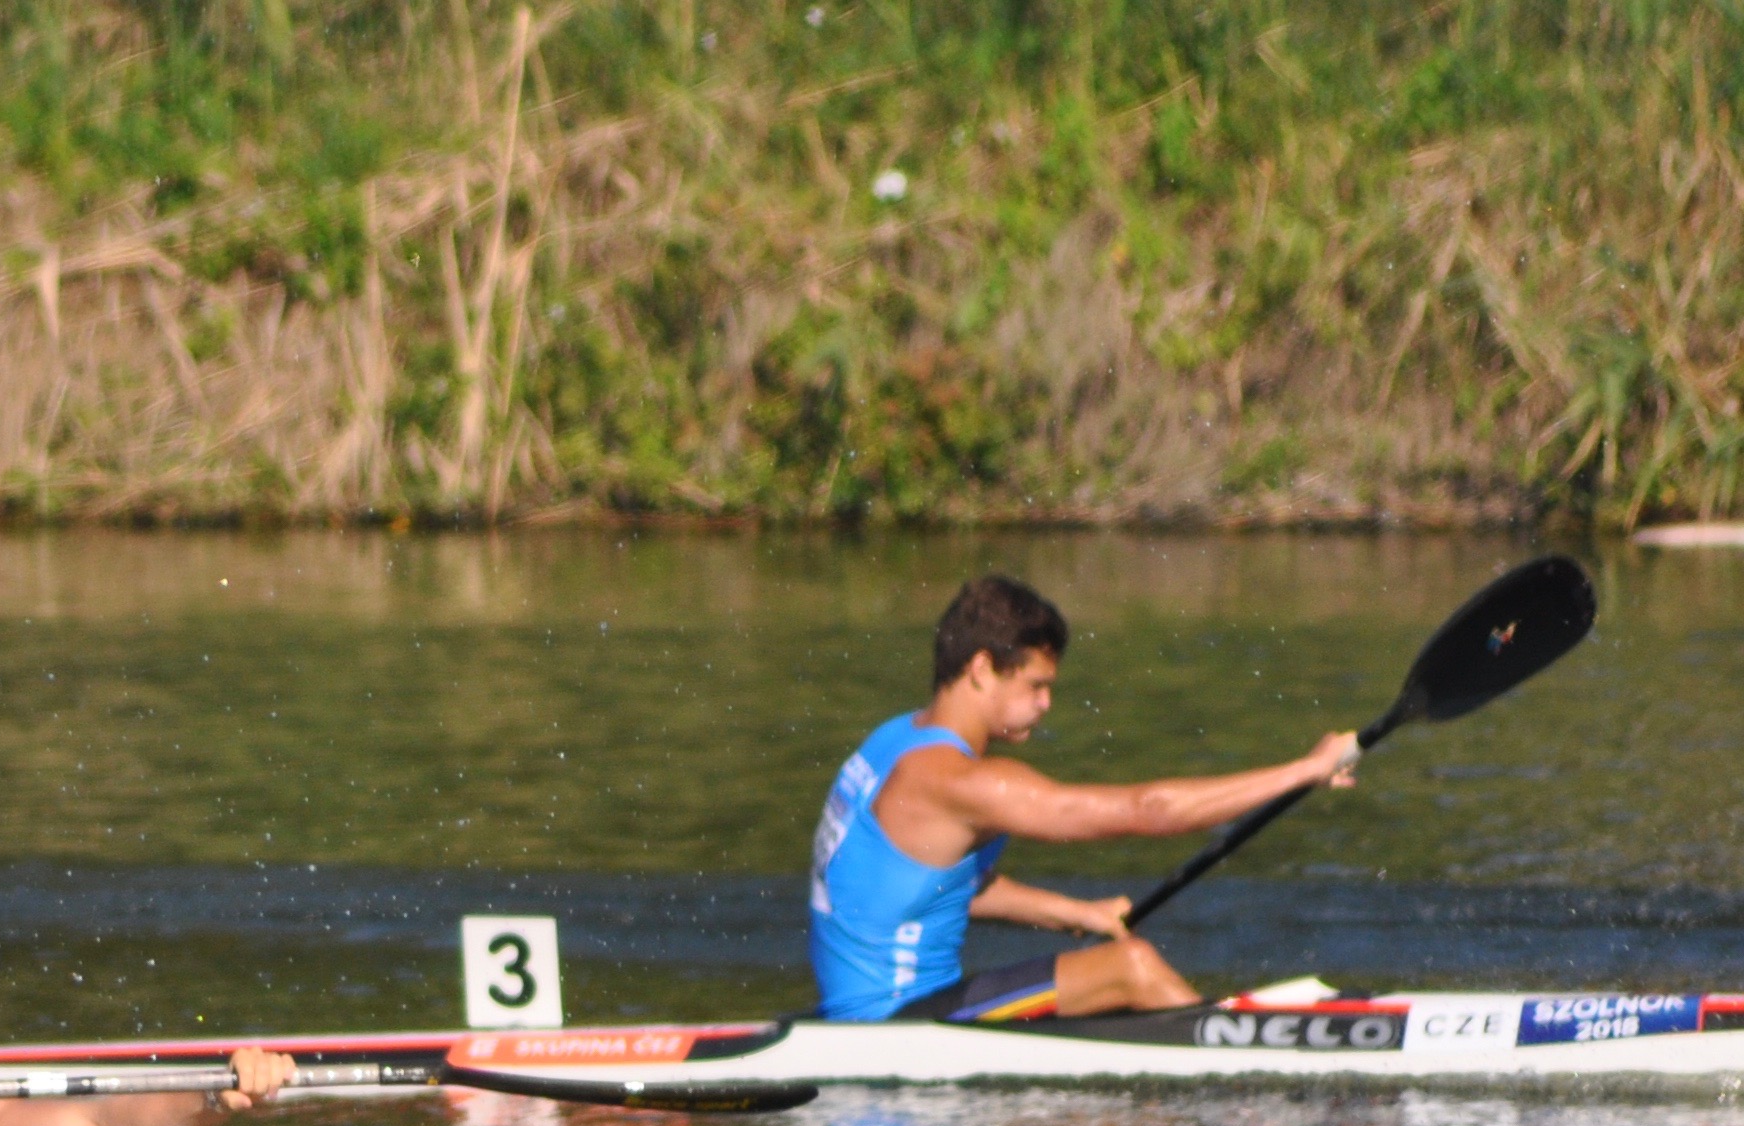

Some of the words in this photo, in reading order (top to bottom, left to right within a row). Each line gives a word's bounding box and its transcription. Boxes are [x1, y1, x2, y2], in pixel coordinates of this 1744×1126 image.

[488, 932, 537, 1008] 3
[1533, 995, 1686, 1024] SZOLNOK
[1203, 1013, 1394, 1048] NELO
[1424, 1013, 1503, 1037] CZE
[1574, 1016, 1641, 1042] 2018
